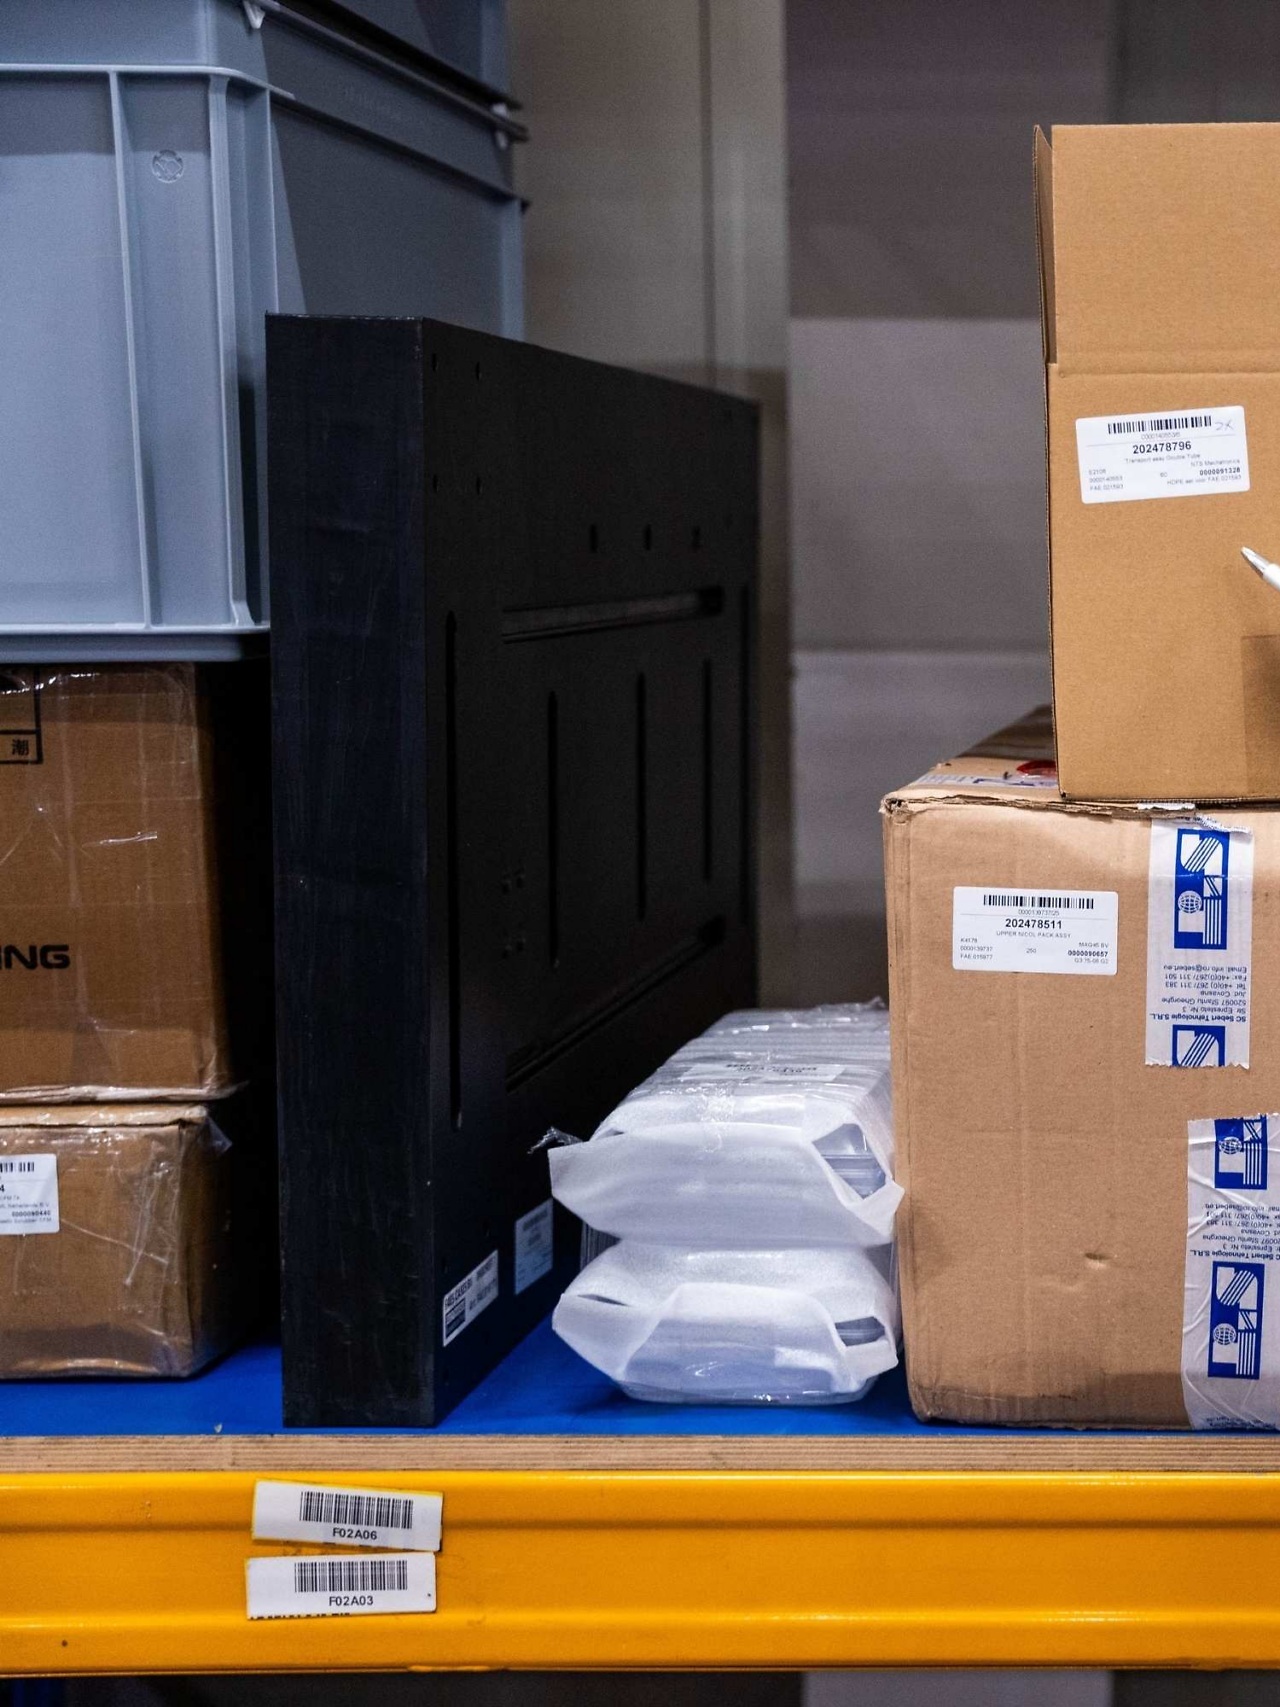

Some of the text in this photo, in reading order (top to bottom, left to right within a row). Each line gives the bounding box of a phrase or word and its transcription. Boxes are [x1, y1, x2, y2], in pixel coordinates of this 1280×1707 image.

[1132, 441, 1192, 454] 202478796
[1005, 918, 1062, 929] 202478511
[0, 944, 71, 970] NG
[1172, 1013, 1209, 1021] Tehnologie
[1211, 1014, 1234, 1022] Sebert
[1236, 1015, 1246, 1023] SC
[332, 1527, 378, 1540] F02A06
[329, 1596, 374, 1607] F02A03
